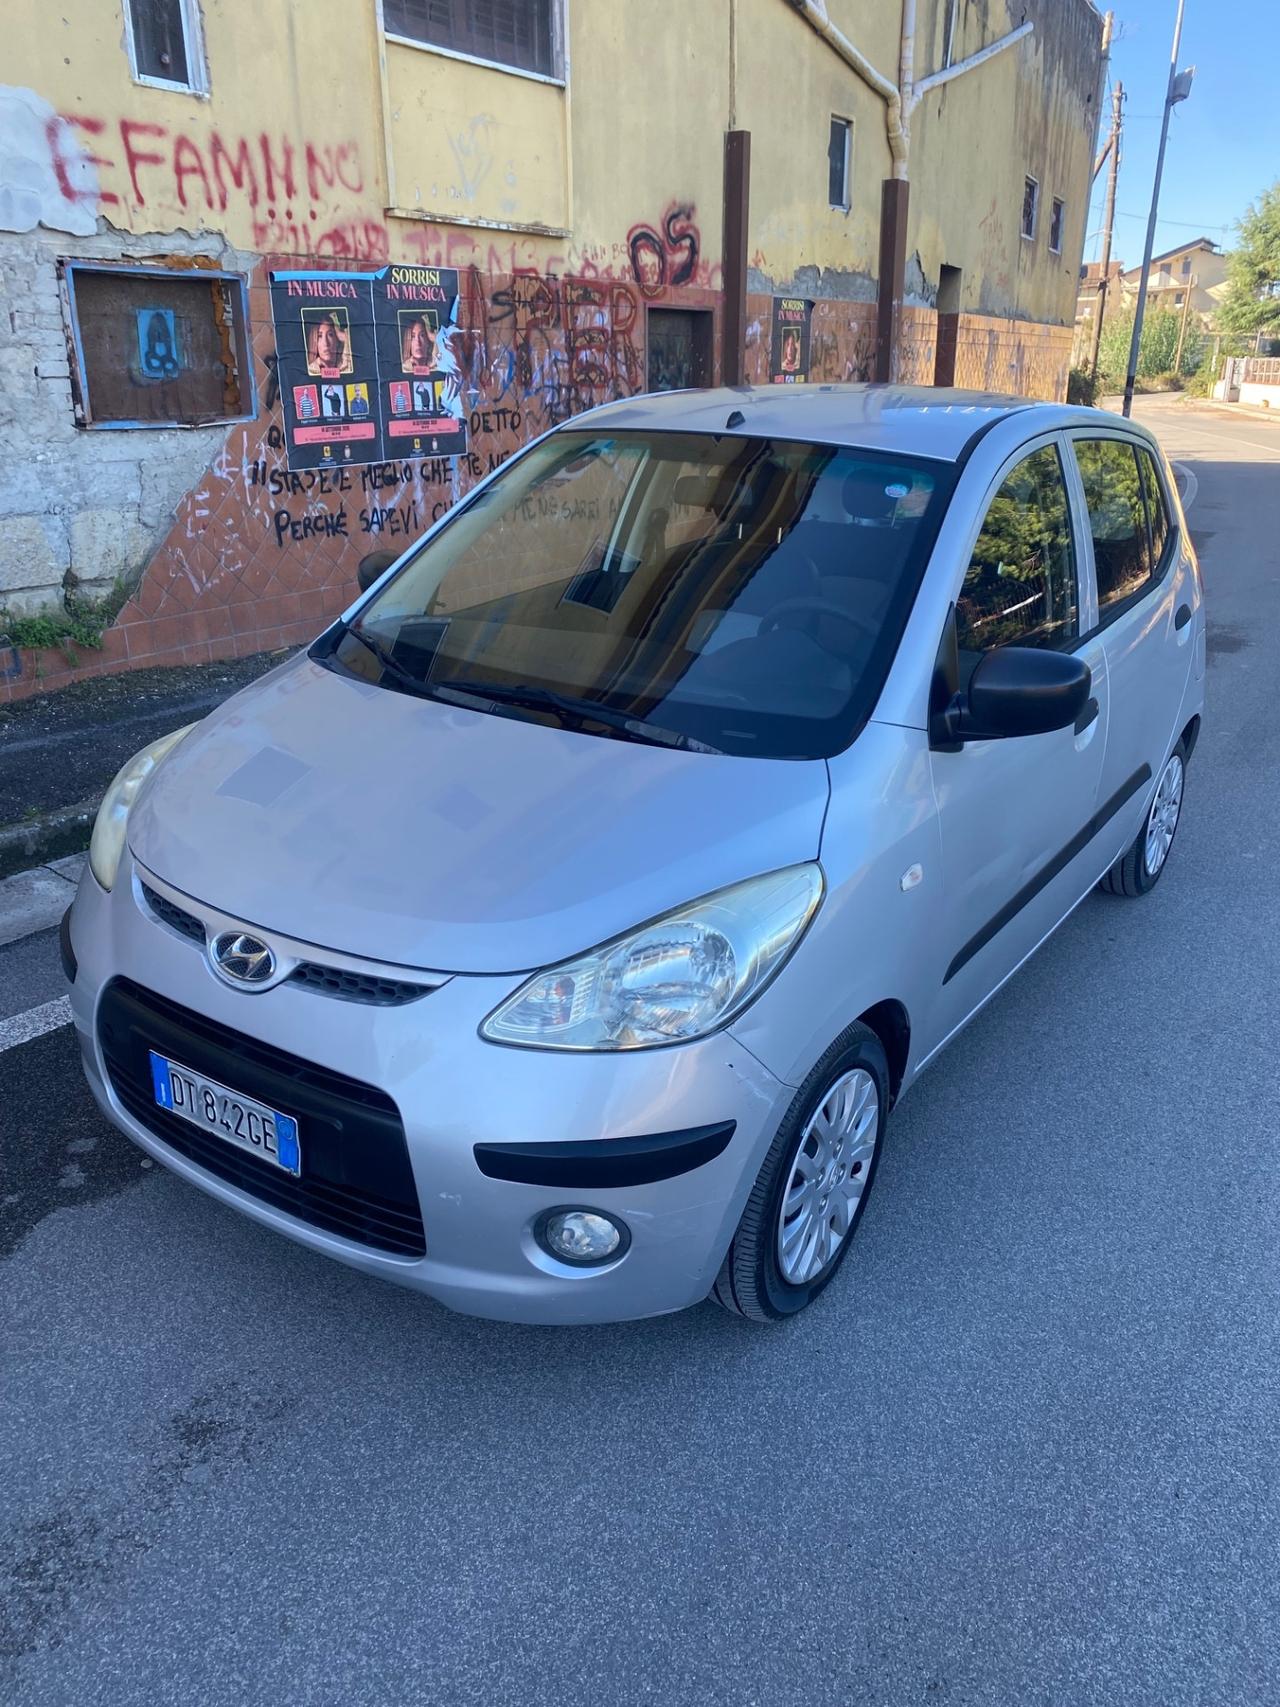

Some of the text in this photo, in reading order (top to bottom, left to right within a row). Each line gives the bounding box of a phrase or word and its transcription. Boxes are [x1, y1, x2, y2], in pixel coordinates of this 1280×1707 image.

[391, 267, 440, 286] SORRISI
[287, 281, 357, 298] IN MUSICA
[386, 284, 446, 302] IN MUSICA
[170, 1071, 196, 1114] DT
[203, 1089, 277, 1155] 842GE
